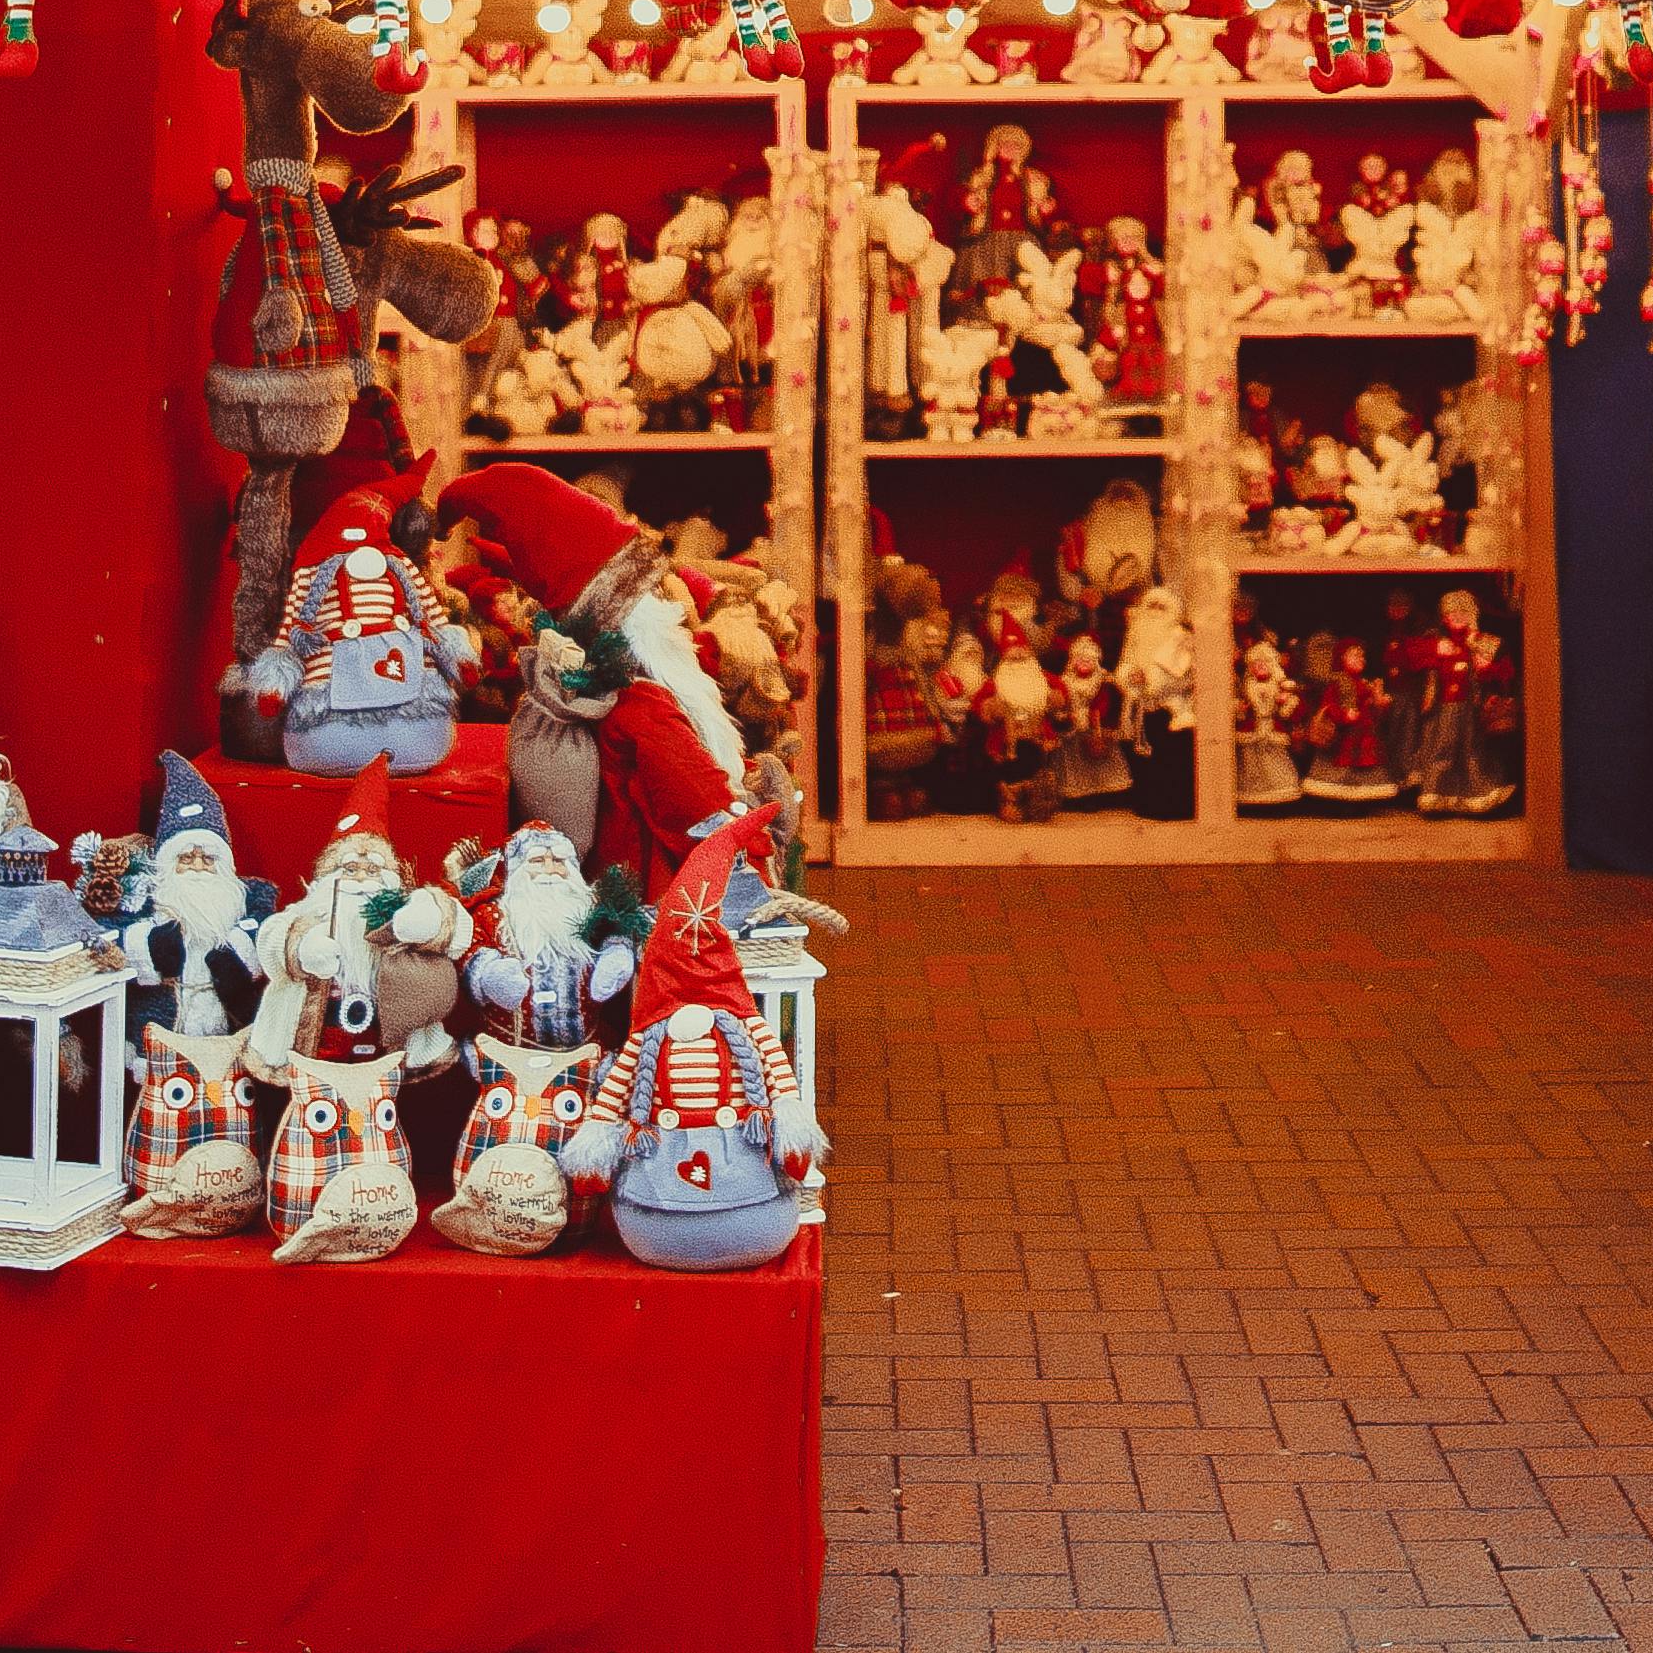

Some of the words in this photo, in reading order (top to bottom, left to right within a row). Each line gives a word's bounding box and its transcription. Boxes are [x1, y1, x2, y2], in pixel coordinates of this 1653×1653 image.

[194, 1160, 244, 1189] Home
[488, 1158, 536, 1191] Home
[351, 1179, 399, 1207] Home
